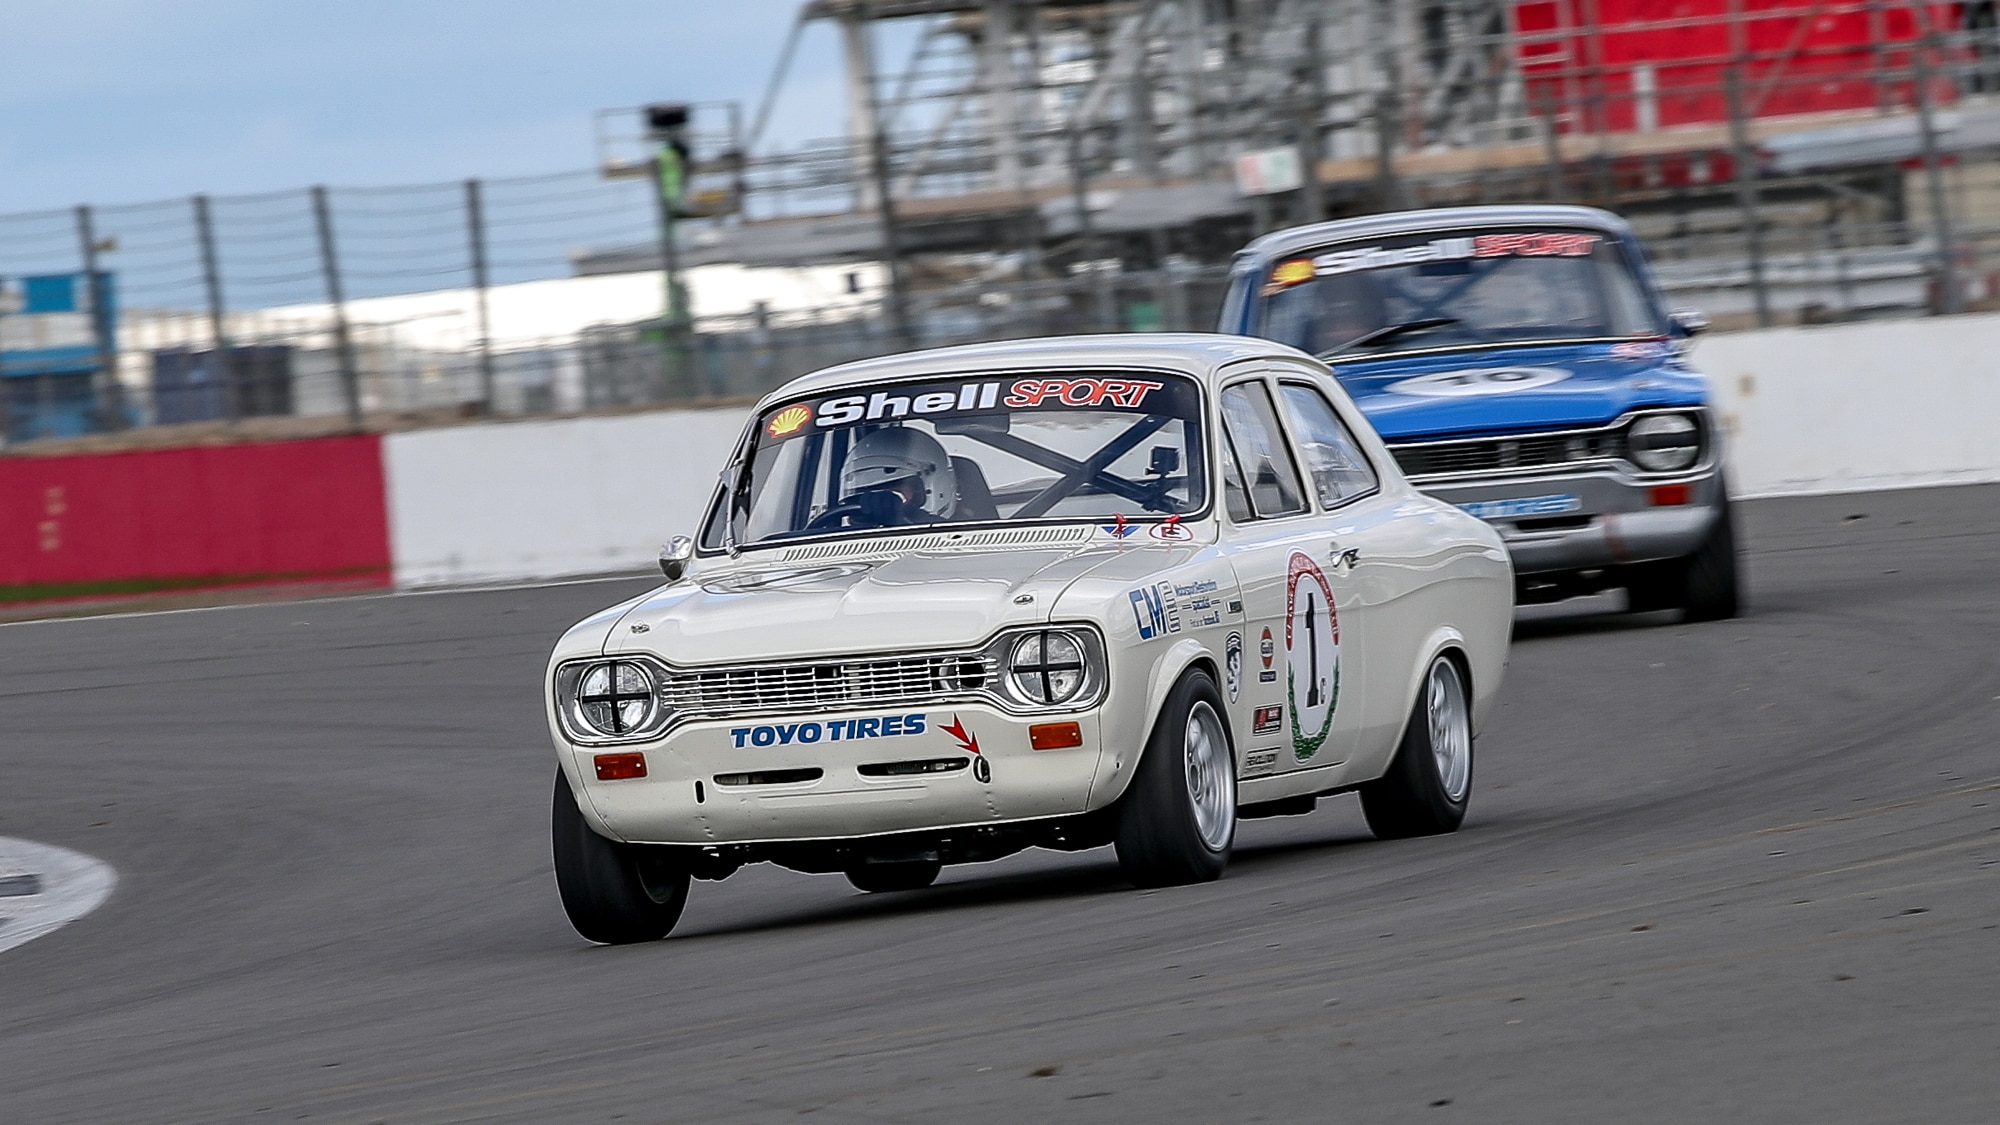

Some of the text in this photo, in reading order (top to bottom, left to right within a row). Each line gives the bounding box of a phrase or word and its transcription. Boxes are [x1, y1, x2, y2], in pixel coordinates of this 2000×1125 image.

[1314, 232, 1602, 276] Shell SPORT
[815, 378, 1164, 427] Shell SPORT
[1161, 526, 1183, 539] E
[1129, 584, 1167, 640] CM
[1305, 592, 1319, 708] 1
[731, 713, 927, 748] TOYO TIRES
